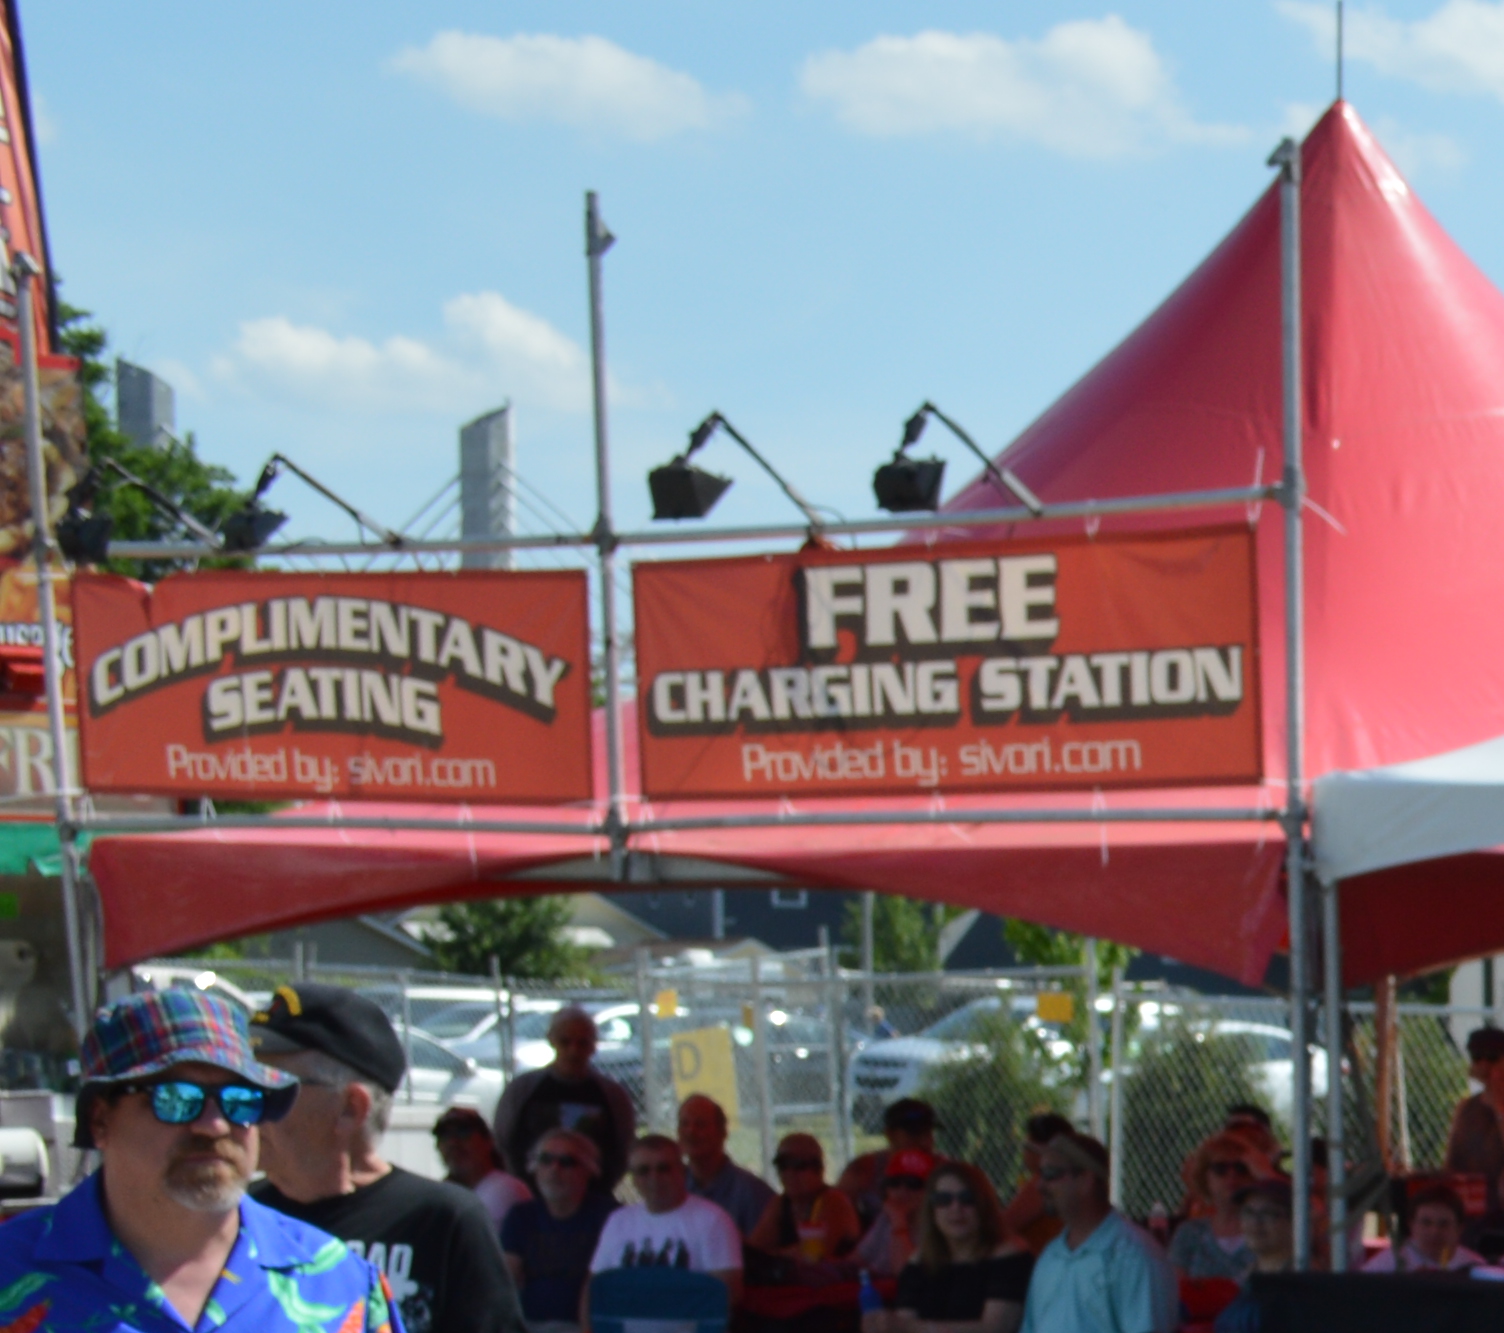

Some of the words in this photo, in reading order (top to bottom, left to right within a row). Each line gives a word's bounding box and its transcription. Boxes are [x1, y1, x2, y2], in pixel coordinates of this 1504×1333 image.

[806, 553, 1059, 649] FREE
[92, 597, 568, 708] COMPLIMENTARY
[653, 660, 958, 724] CHARGING
[979, 645, 1243, 712] STATION
[206, 667, 442, 735] SEATING
[167, 744, 286, 782] Provided
[294, 748, 339, 792] by:
[349, 751, 496, 787] sivori.com
[743, 741, 884, 782] Provided
[893, 742, 948, 786] by:
[959, 737, 1141, 776] sivori.com
